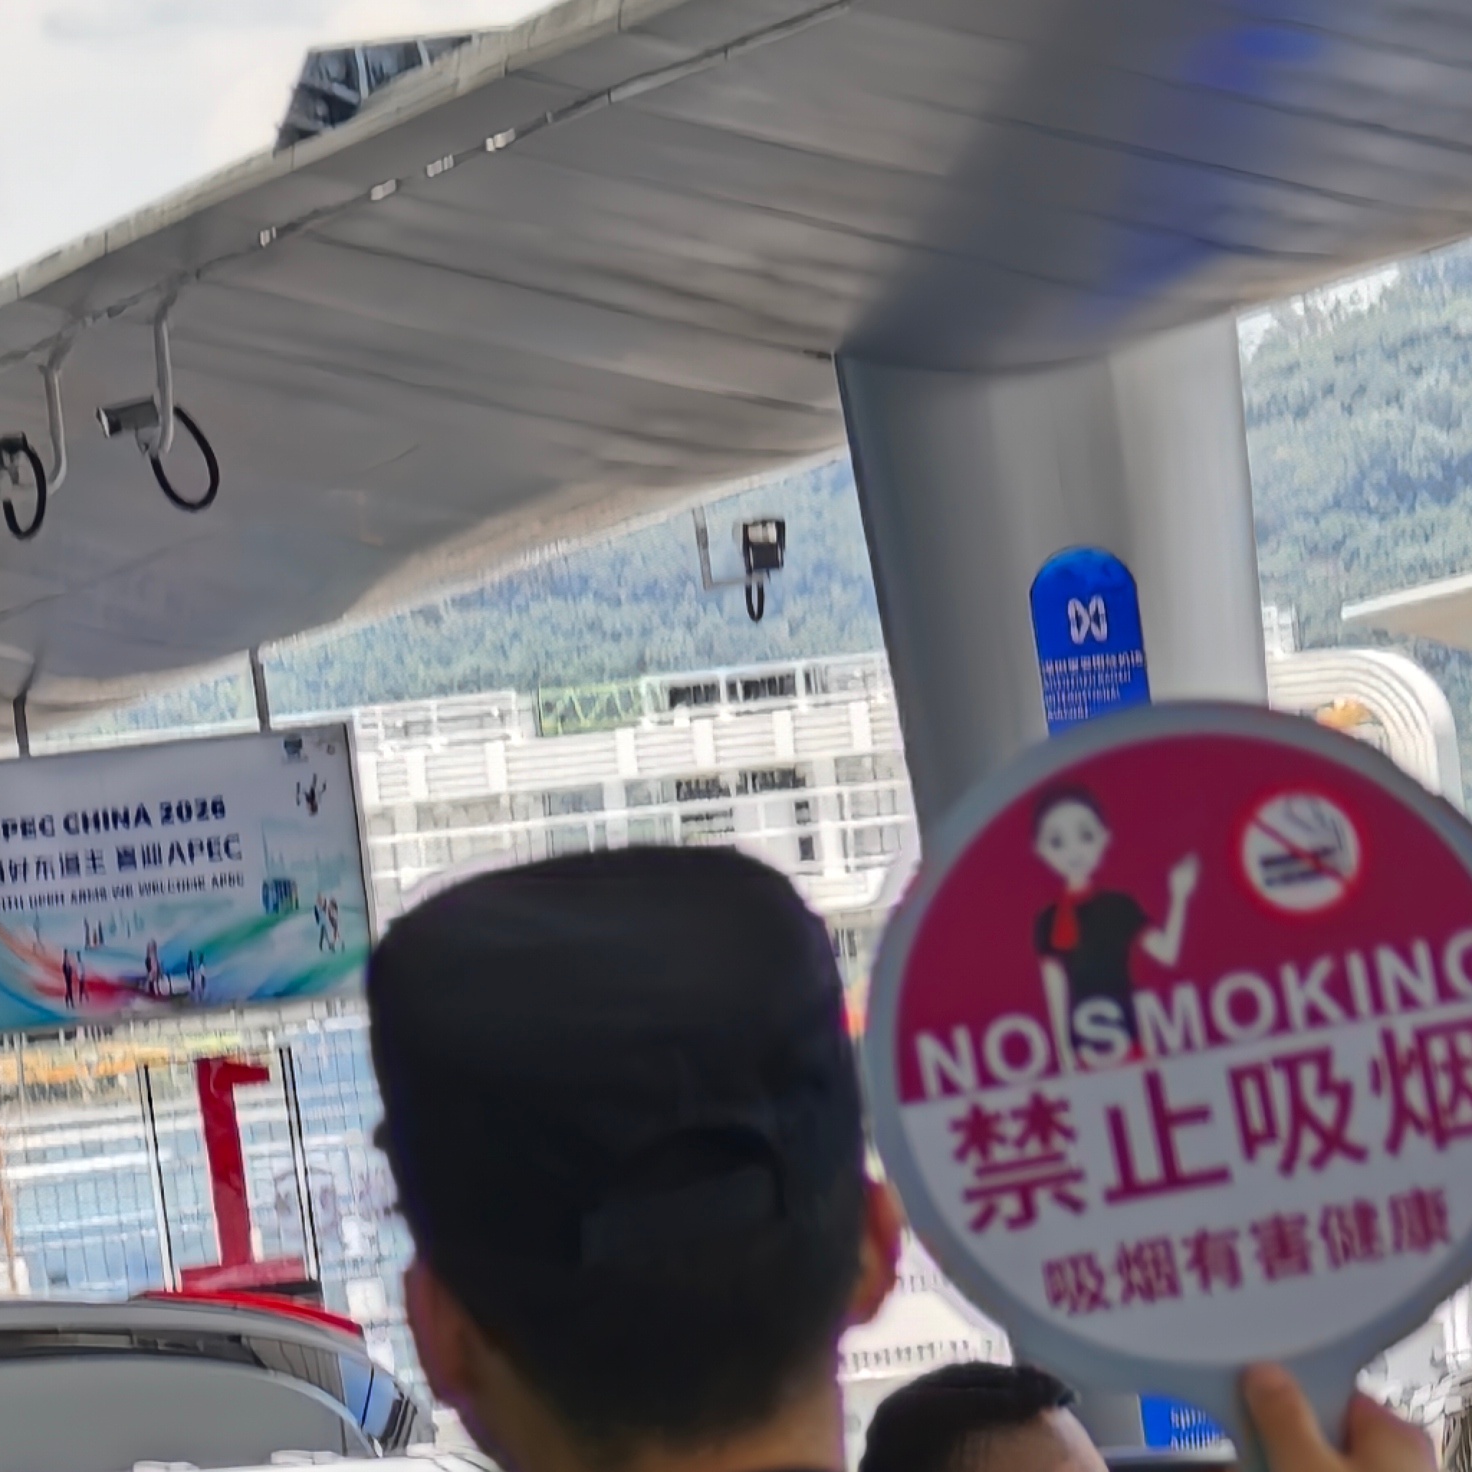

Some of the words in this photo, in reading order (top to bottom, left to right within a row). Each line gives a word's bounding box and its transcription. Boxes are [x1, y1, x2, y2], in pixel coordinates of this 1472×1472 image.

[62, 802, 153, 837] CHINA
[158, 793, 226, 827] 2026
[916, 1012, 1055, 1099] NO
[1043, 1184, 1451, 1321] 吸烟有害健康
